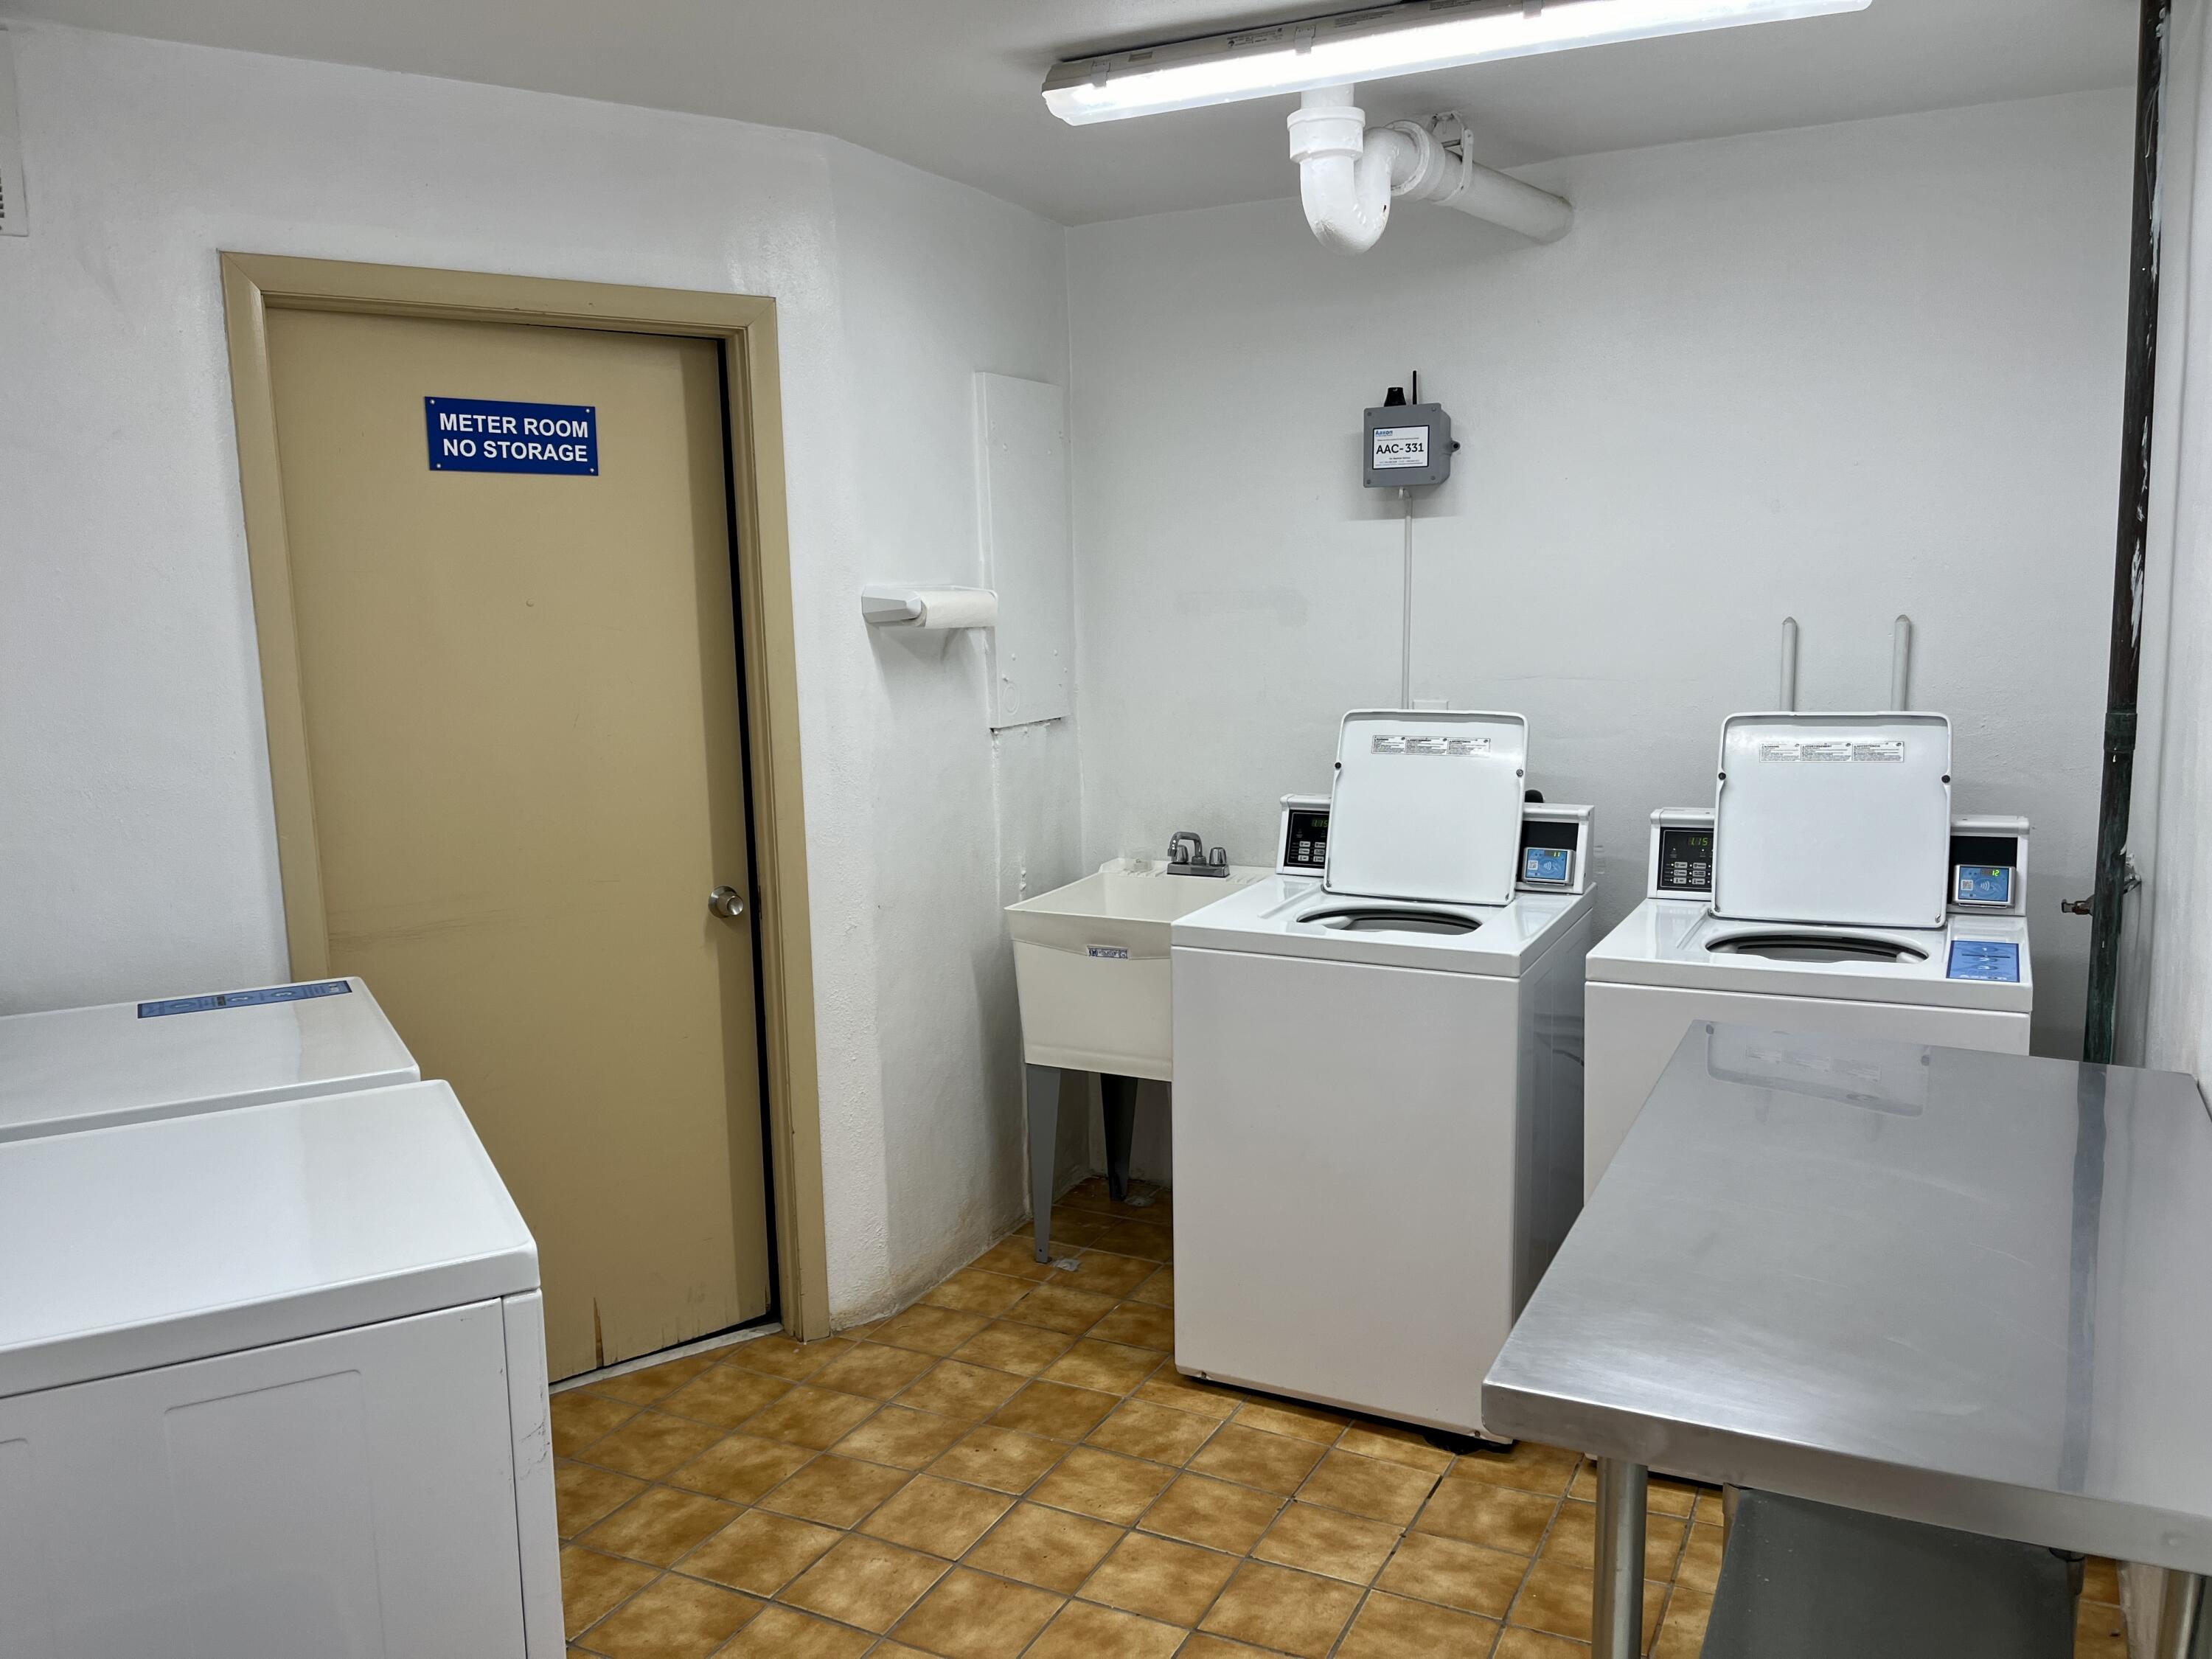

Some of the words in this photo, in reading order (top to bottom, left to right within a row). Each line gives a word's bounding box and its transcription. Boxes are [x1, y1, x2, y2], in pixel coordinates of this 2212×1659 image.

[439, 413, 517, 434] METER
[524, 418, 588, 438] ROOM
[443, 439, 476, 457] NO
[484, 440, 588, 462] STORAGE
[1376, 442, 1424, 454] AAC-331
